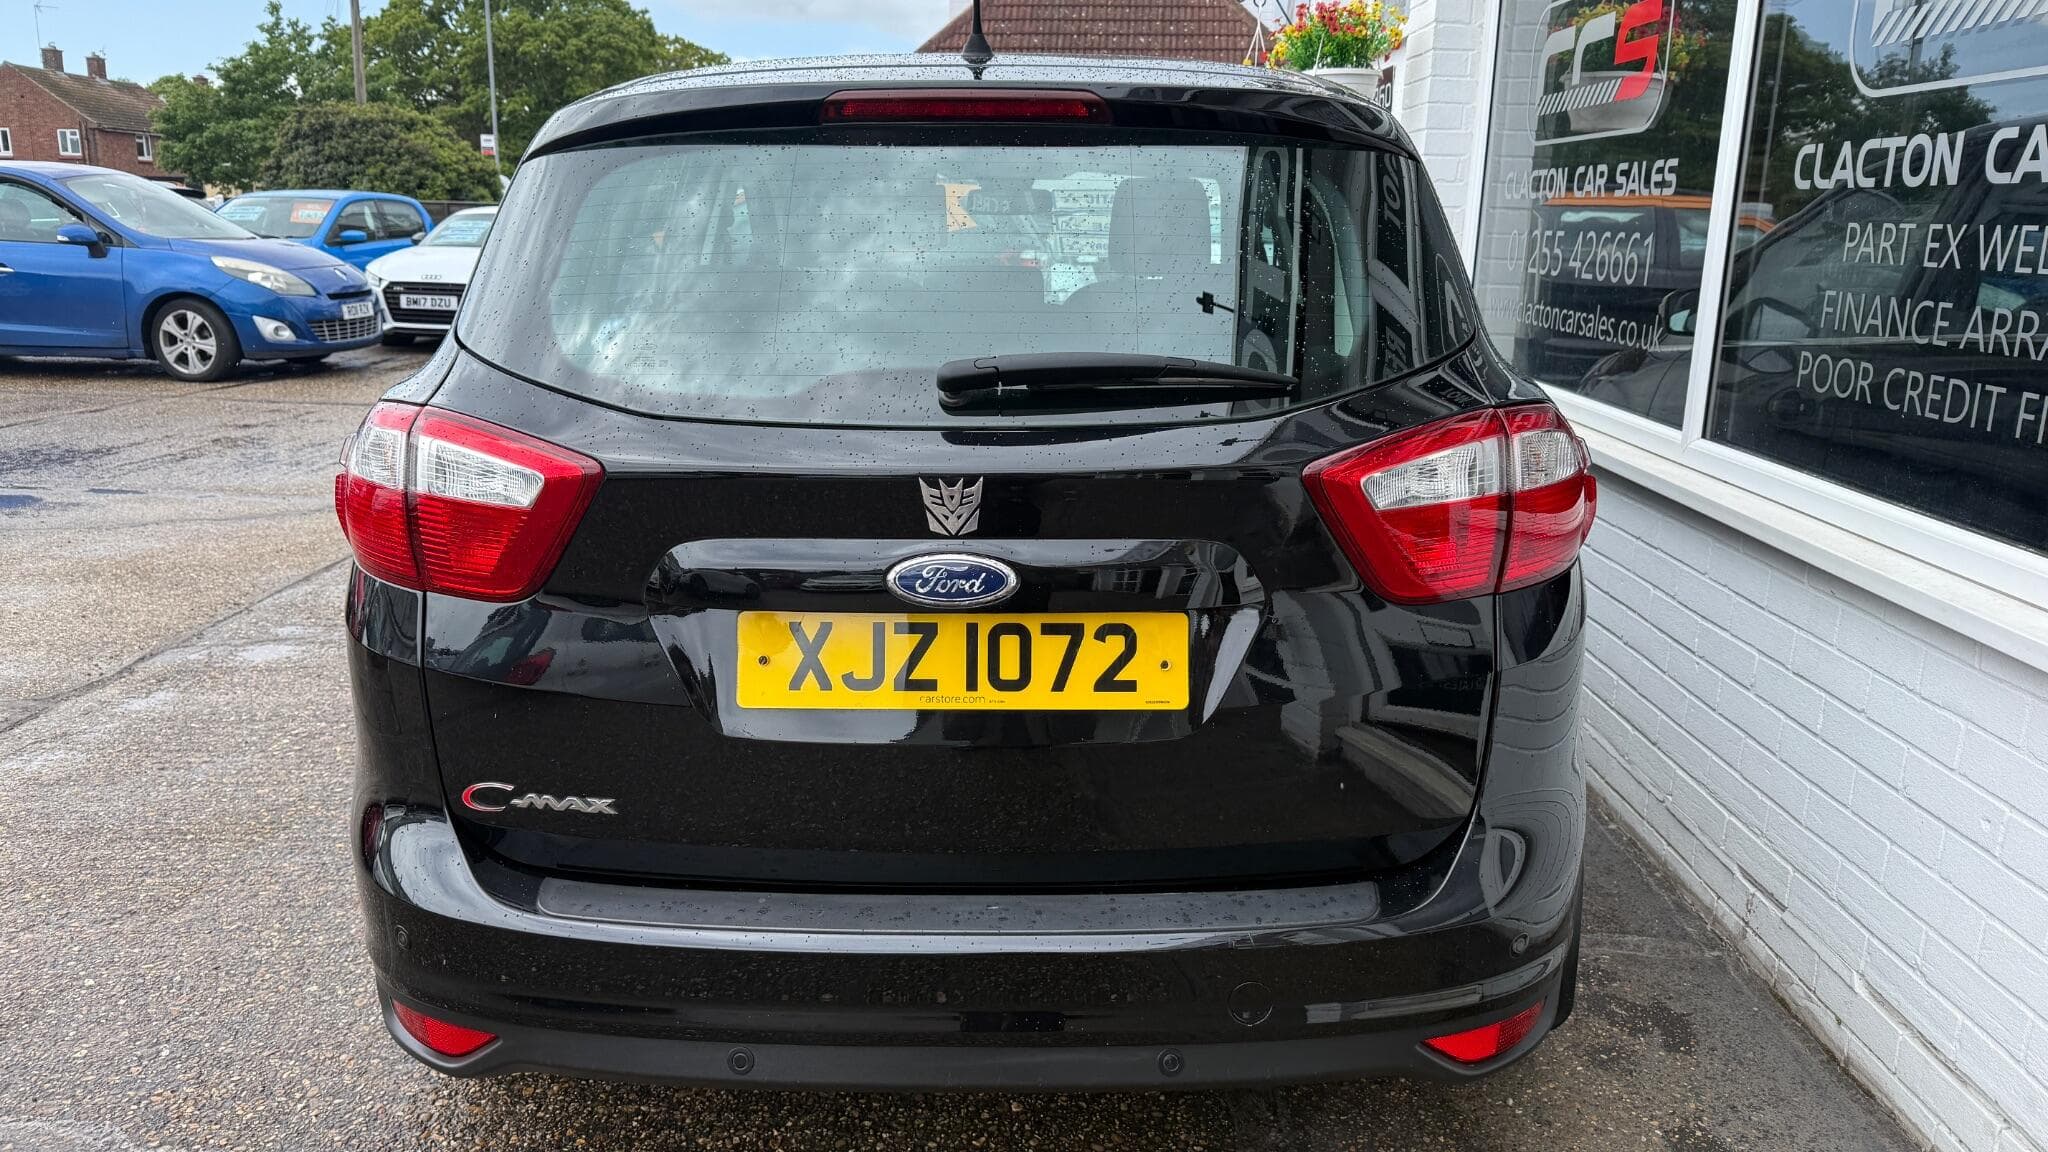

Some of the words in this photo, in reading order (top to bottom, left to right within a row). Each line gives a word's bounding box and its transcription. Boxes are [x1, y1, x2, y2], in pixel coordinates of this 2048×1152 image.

[1505, 166, 1568, 200] CLACTON
[1573, 163, 1609, 198] CAR
[1614, 157, 1679, 197] SALES
[1794, 131, 1966, 190] CLACTON
[1507, 229, 1565, 277] 01255
[1568, 231, 1655, 287] 426661
[1842, 222, 1917, 266] PART
[1923, 223, 1968, 270] EX
[405, 296, 428, 306] BM17
[430, 296, 452, 309] DZU
[1489, 294, 1664, 353] www.clactoncarsales.co.uk
[1820, 290, 1954, 347] FINANCE
[1959, 306, 2048, 361] ARR
[1796, 350, 1874, 405] POOR
[1883, 367, 2007, 433] CREDIT
[914, 564, 986, 596] Ford
[788, 621, 938, 692] XJZ
[965, 622, 1138, 693] 1072
[919, 694, 986, 705] carstore.com
[461, 782, 619, 815] C-MAX
